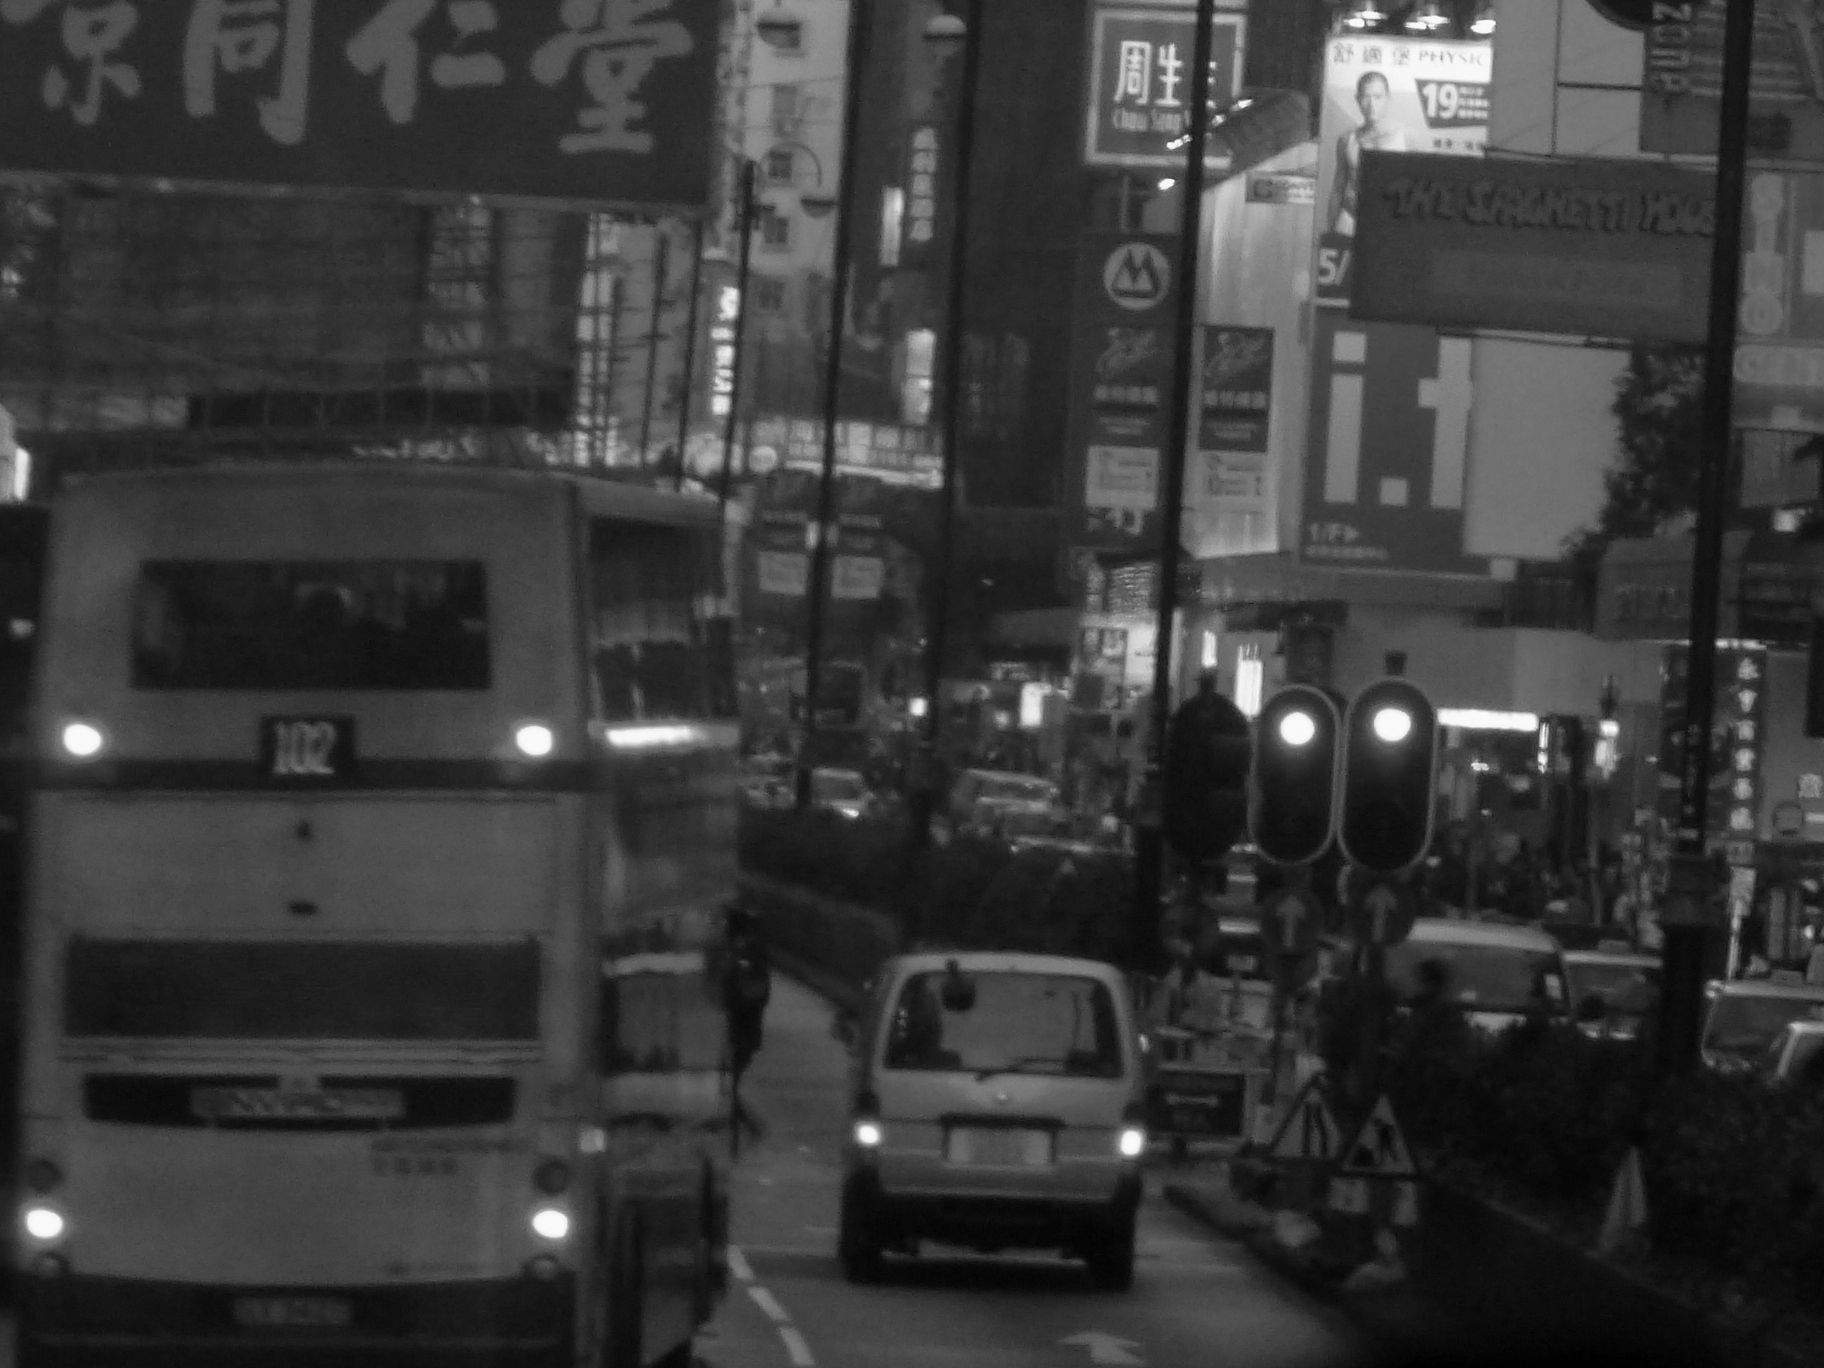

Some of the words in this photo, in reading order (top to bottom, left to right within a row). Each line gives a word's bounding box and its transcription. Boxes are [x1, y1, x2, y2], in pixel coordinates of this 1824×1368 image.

[1422, 82, 1459, 119] 19
[1462, 179, 1630, 233] SPAGHETTI
[274, 720, 336, 775] 102
